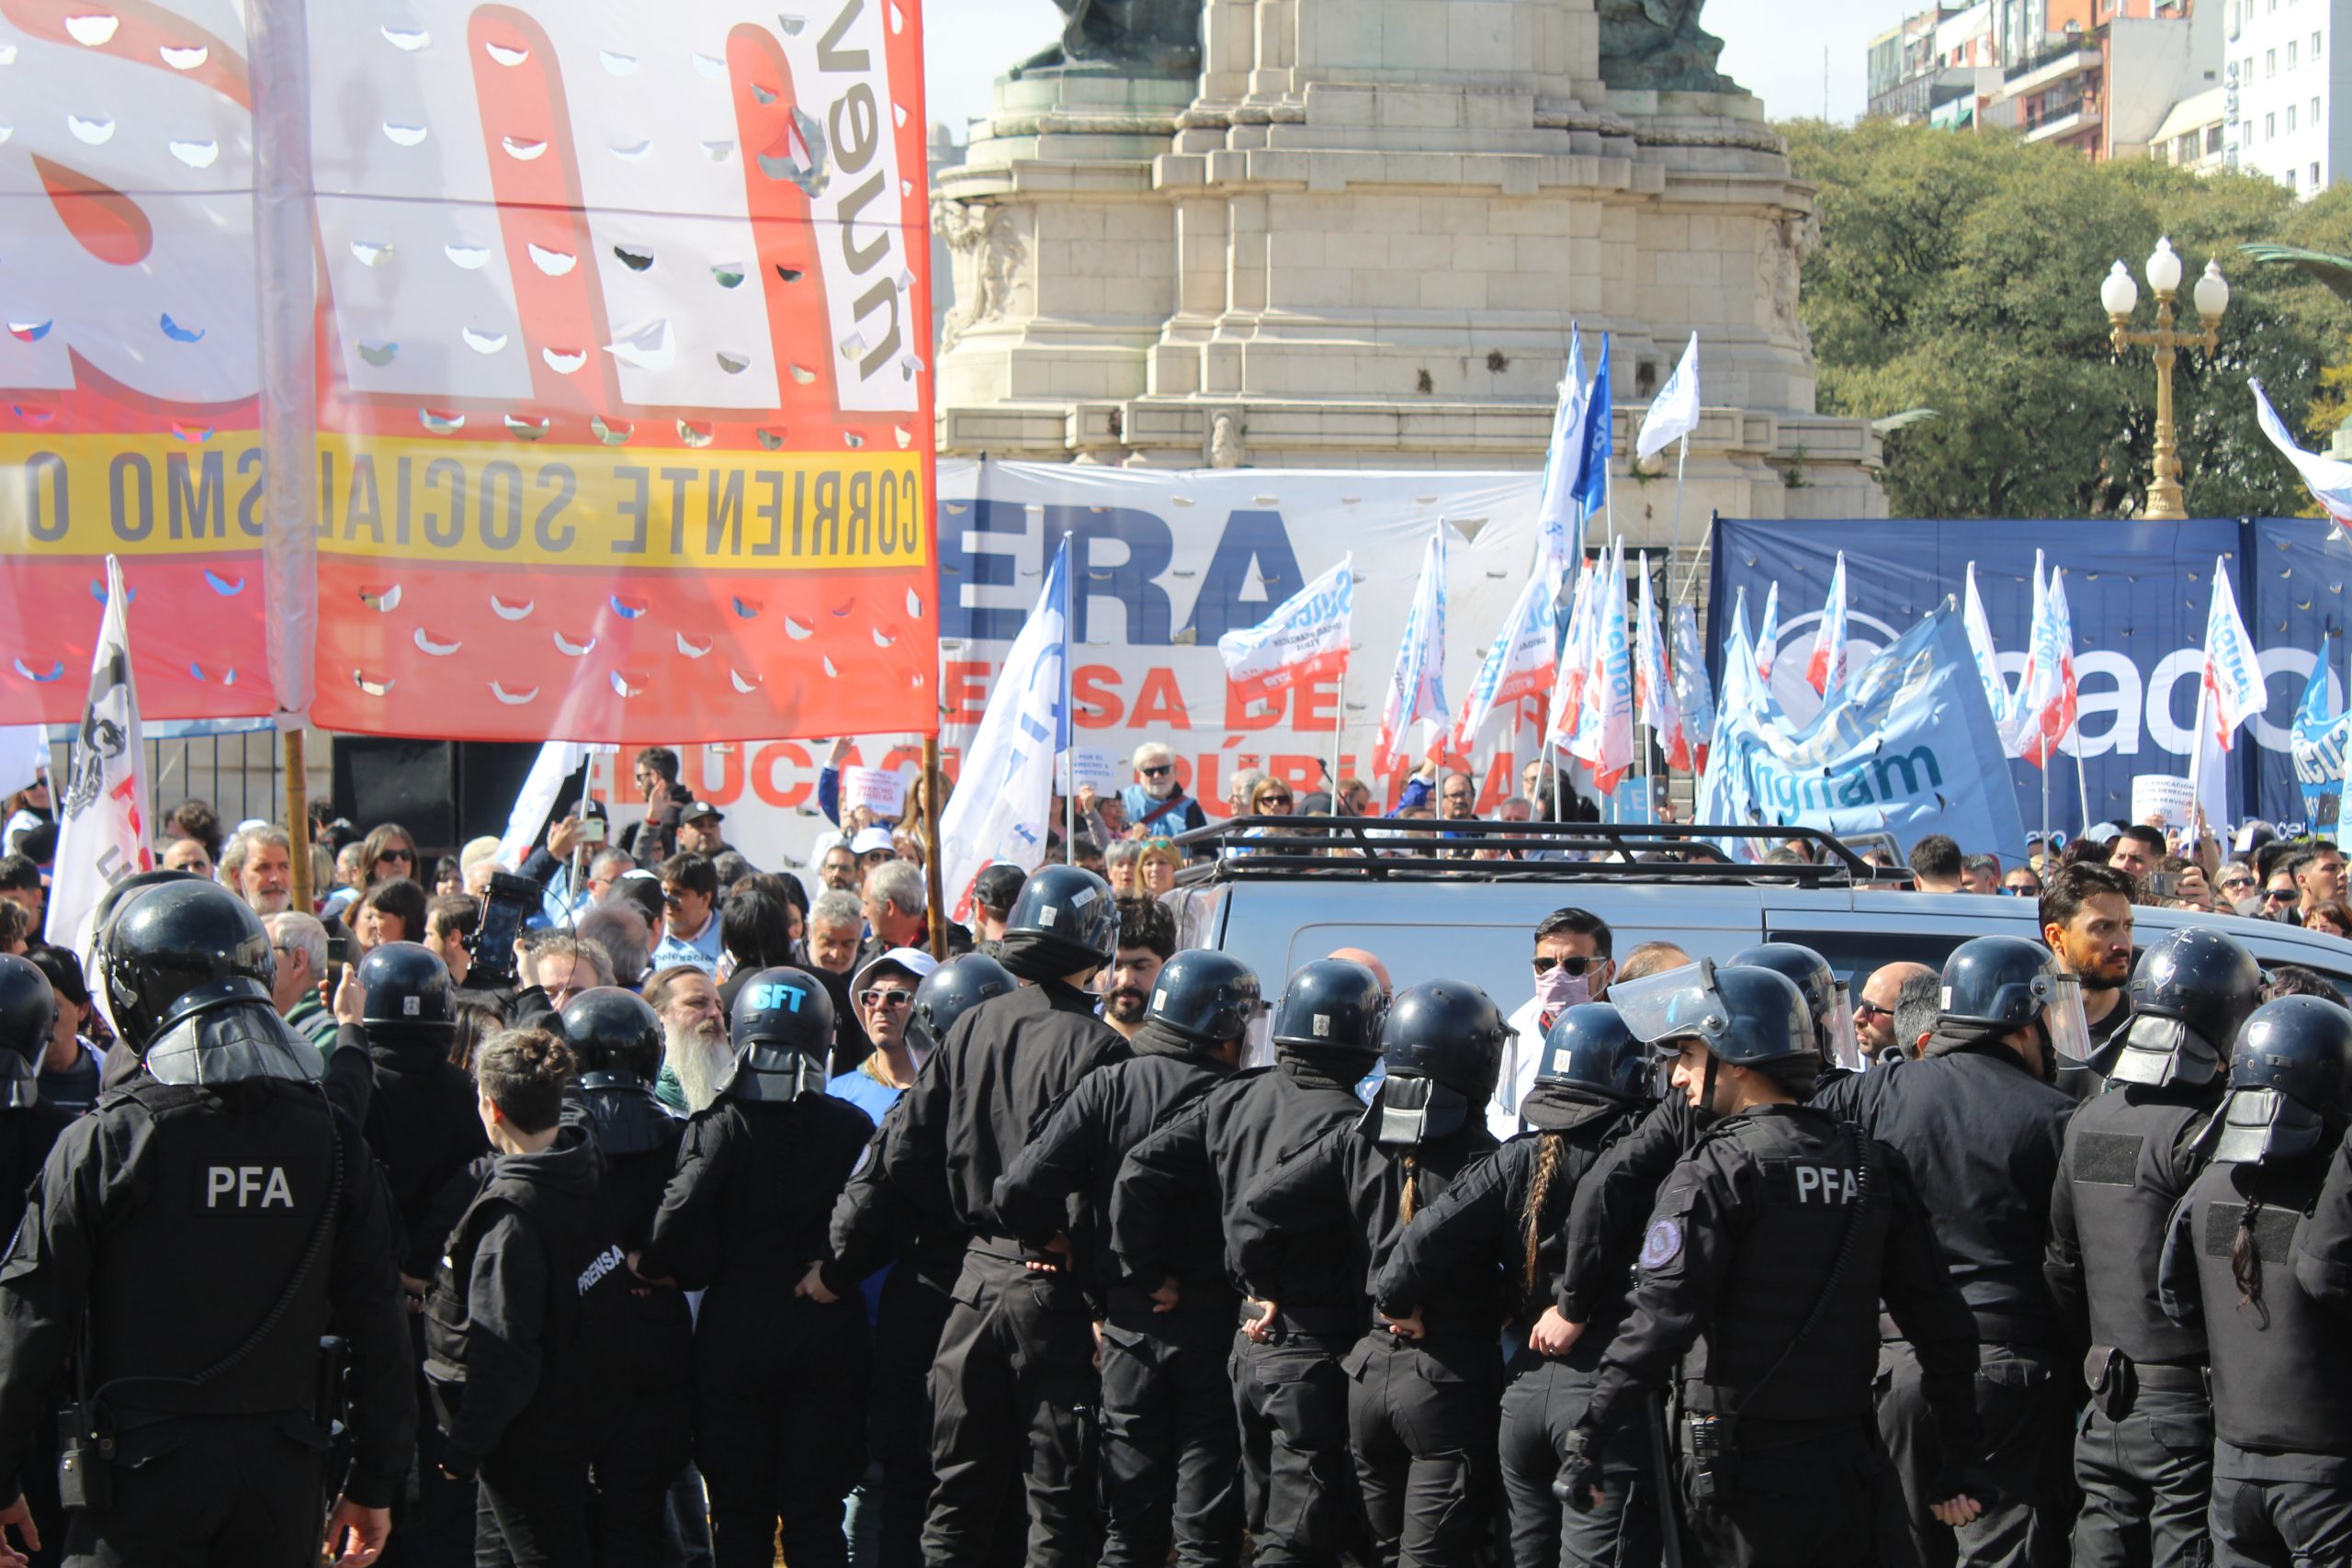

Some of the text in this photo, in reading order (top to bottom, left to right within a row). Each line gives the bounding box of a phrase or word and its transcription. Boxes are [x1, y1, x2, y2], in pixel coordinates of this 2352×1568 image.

[752, 983, 807, 1013] SFT
[207, 1166, 295, 1208] PFA
[1795, 1166, 1859, 1204] PFA
[577, 1244, 626, 1296] PRENSA
